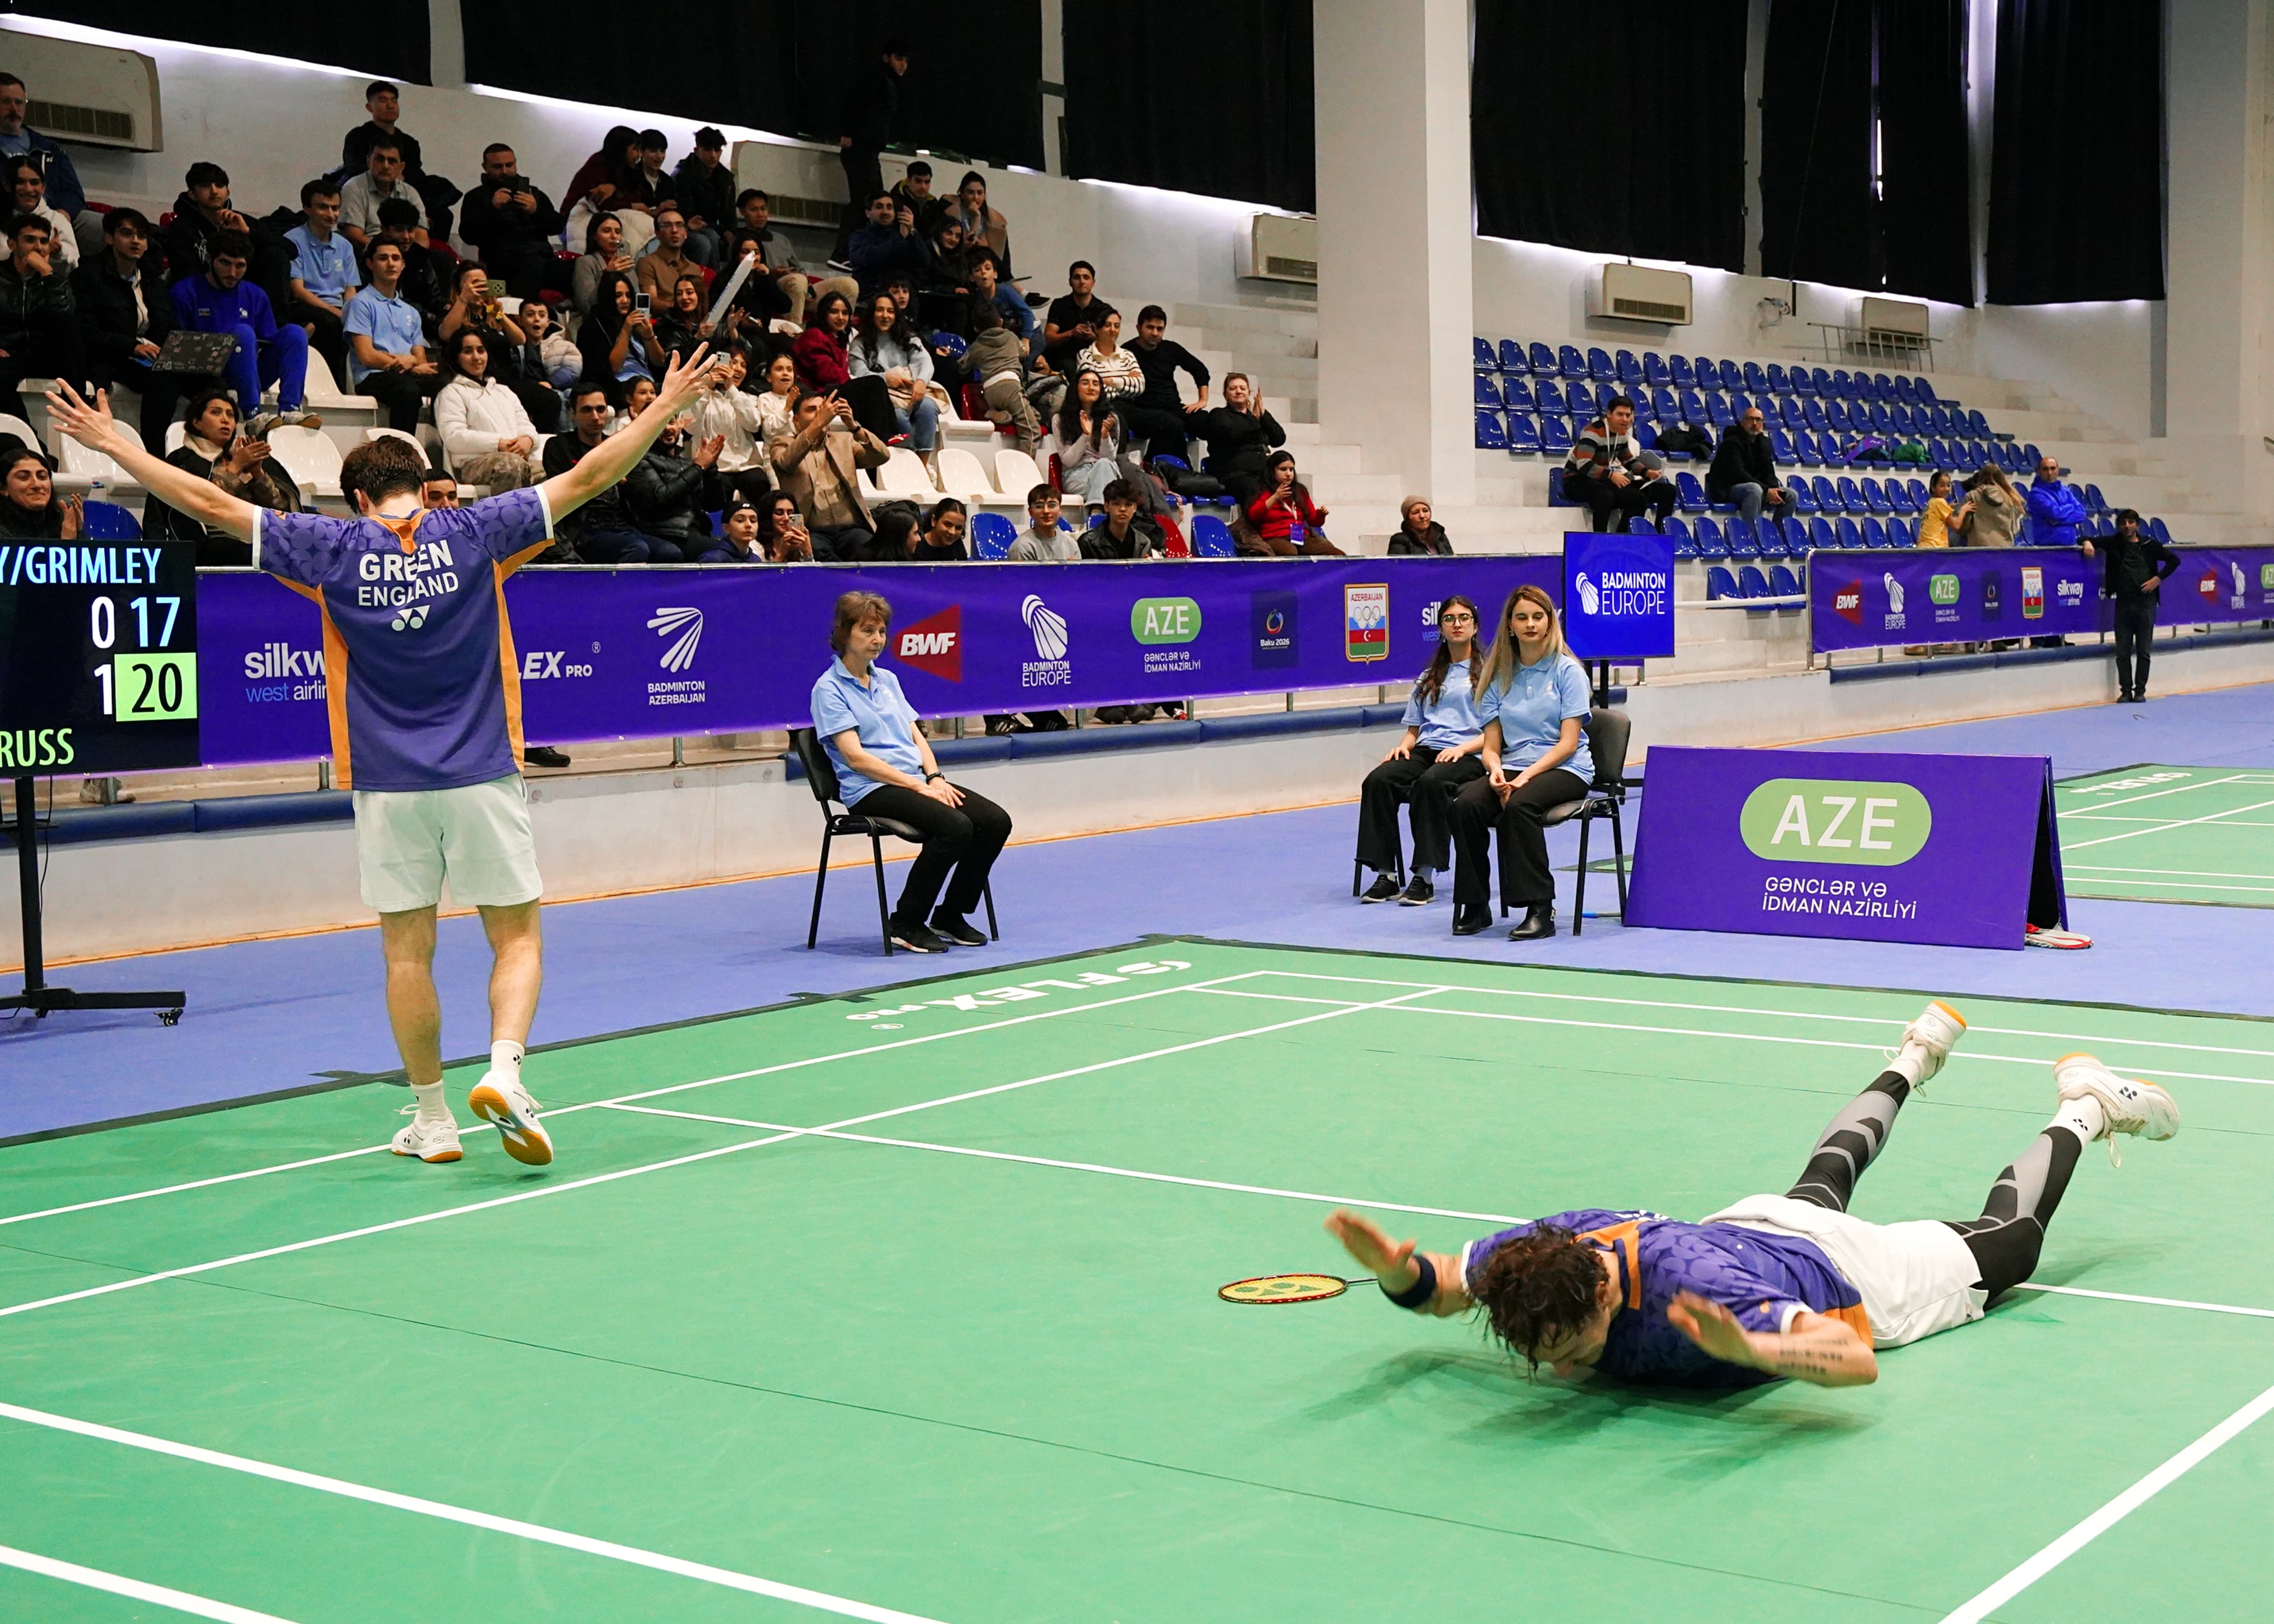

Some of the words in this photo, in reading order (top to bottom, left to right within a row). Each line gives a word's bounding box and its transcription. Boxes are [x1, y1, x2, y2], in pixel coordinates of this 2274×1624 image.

[359, 540, 454, 582] GREEN
[358, 571, 459, 606] ENGLAND
[1602, 572, 1666, 589] BADMINTON
[1936, 580, 1955, 599] AZE
[2057, 579, 2084, 599] silkway
[1351, 593, 1384, 602] AZERBAIJAN
[1602, 591, 1666, 615] EUROPE
[1836, 595, 1859, 609] BWF
[91, 596, 115, 649] 0
[131, 597, 180, 647] 17
[1144, 606, 1189, 636] AZE
[1885, 619, 1906, 630] EUROPE
[900, 632, 956, 656] BWF
[1275, 638, 1290, 646] 2026
[244, 643, 326, 679] silkw
[518, 651, 565, 680] EX
[566, 664, 593, 678] PRO
[1022, 660, 1070, 672] BADMINTON
[1144, 652, 1177, 663] GƏNCLƏR
[1179, 651, 1190, 660] VƏ
[648, 681, 705, 694] BADMINTON
[1022, 670, 1071, 687] EUROPE
[94, 664, 113, 715] 1
[132, 663, 183, 713] 20
[245, 683, 289, 702] west
[648, 693, 706, 706] AZERBAIJAN
[1771, 795, 1897, 849] AZE
[1765, 876, 1855, 897] GƏNCLƏR
[1861, 881, 1887, 898] VƏ
[1762, 892, 1824, 913] İDMAN
[1827, 899, 1917, 920] NAZİRLİYİ
